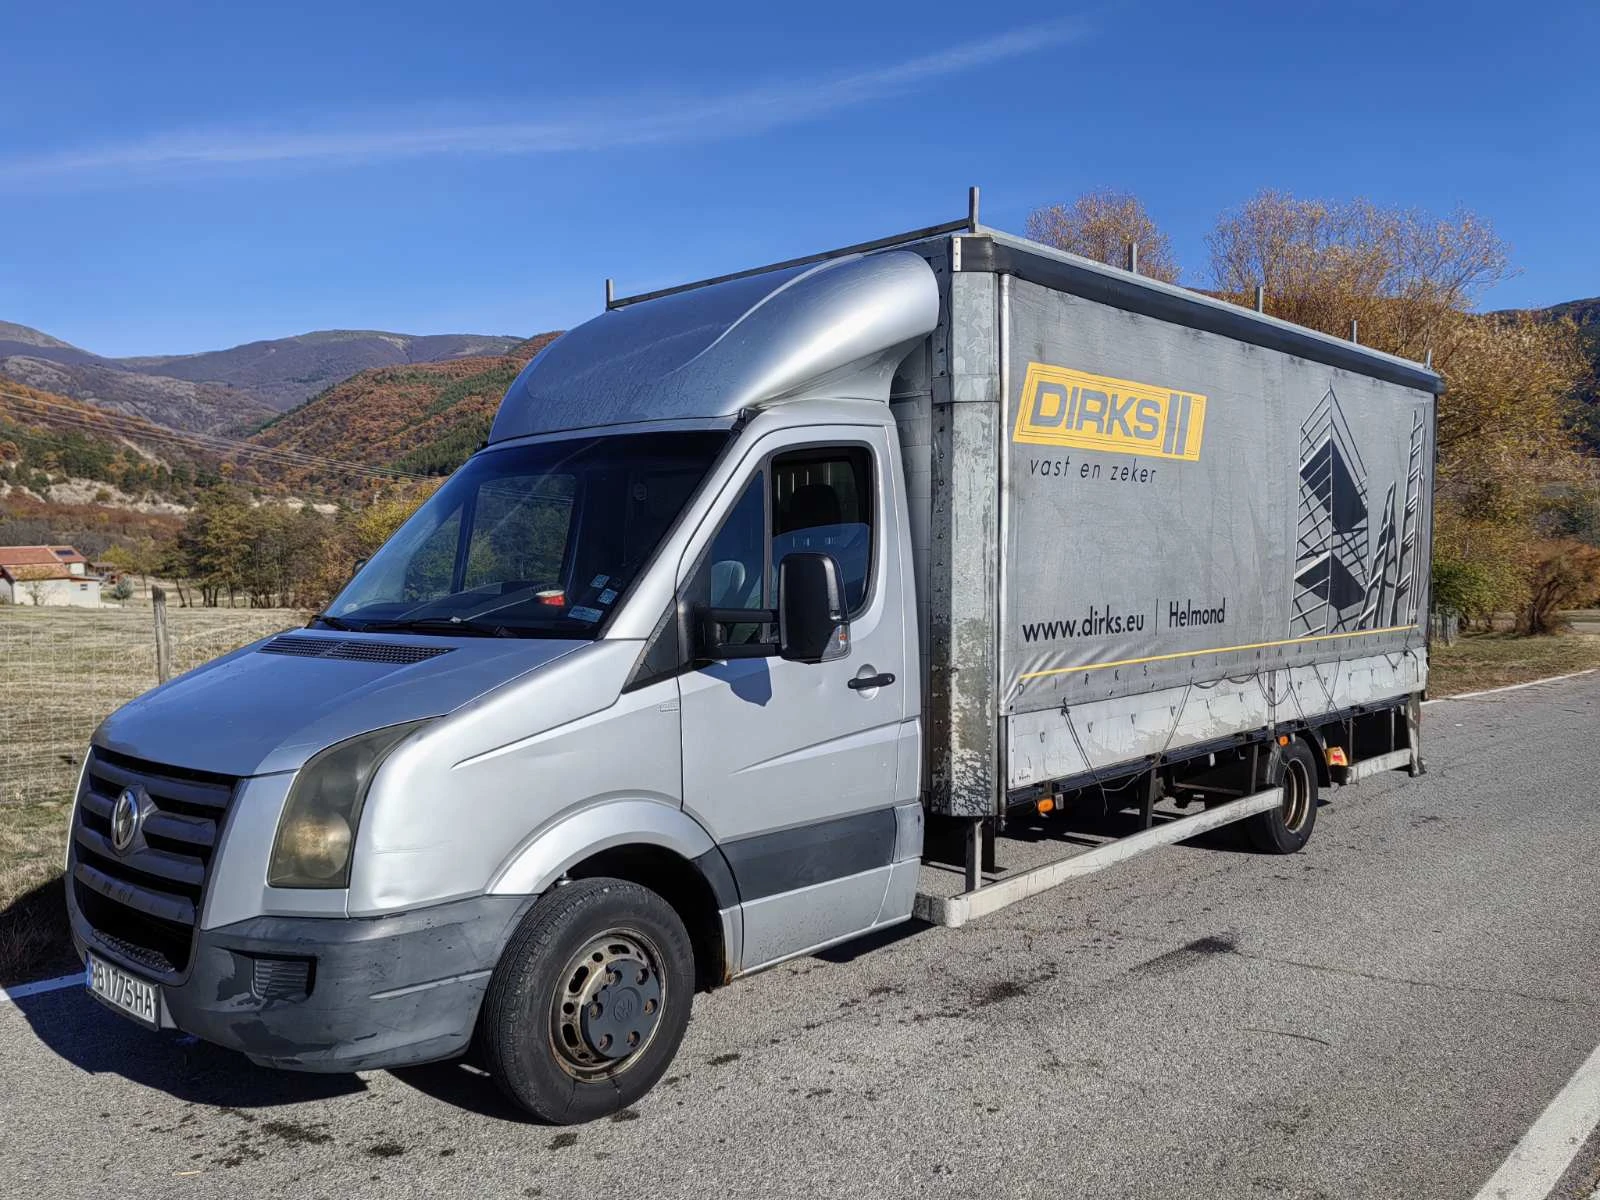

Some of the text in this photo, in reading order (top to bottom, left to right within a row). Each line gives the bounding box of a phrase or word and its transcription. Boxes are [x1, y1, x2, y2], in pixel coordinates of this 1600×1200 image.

[1029, 381, 1161, 440] DIRKS
[1030, 456, 1156, 484] vast en zeker
[1022, 598, 1226, 641] www.dirks.eu Helmond
